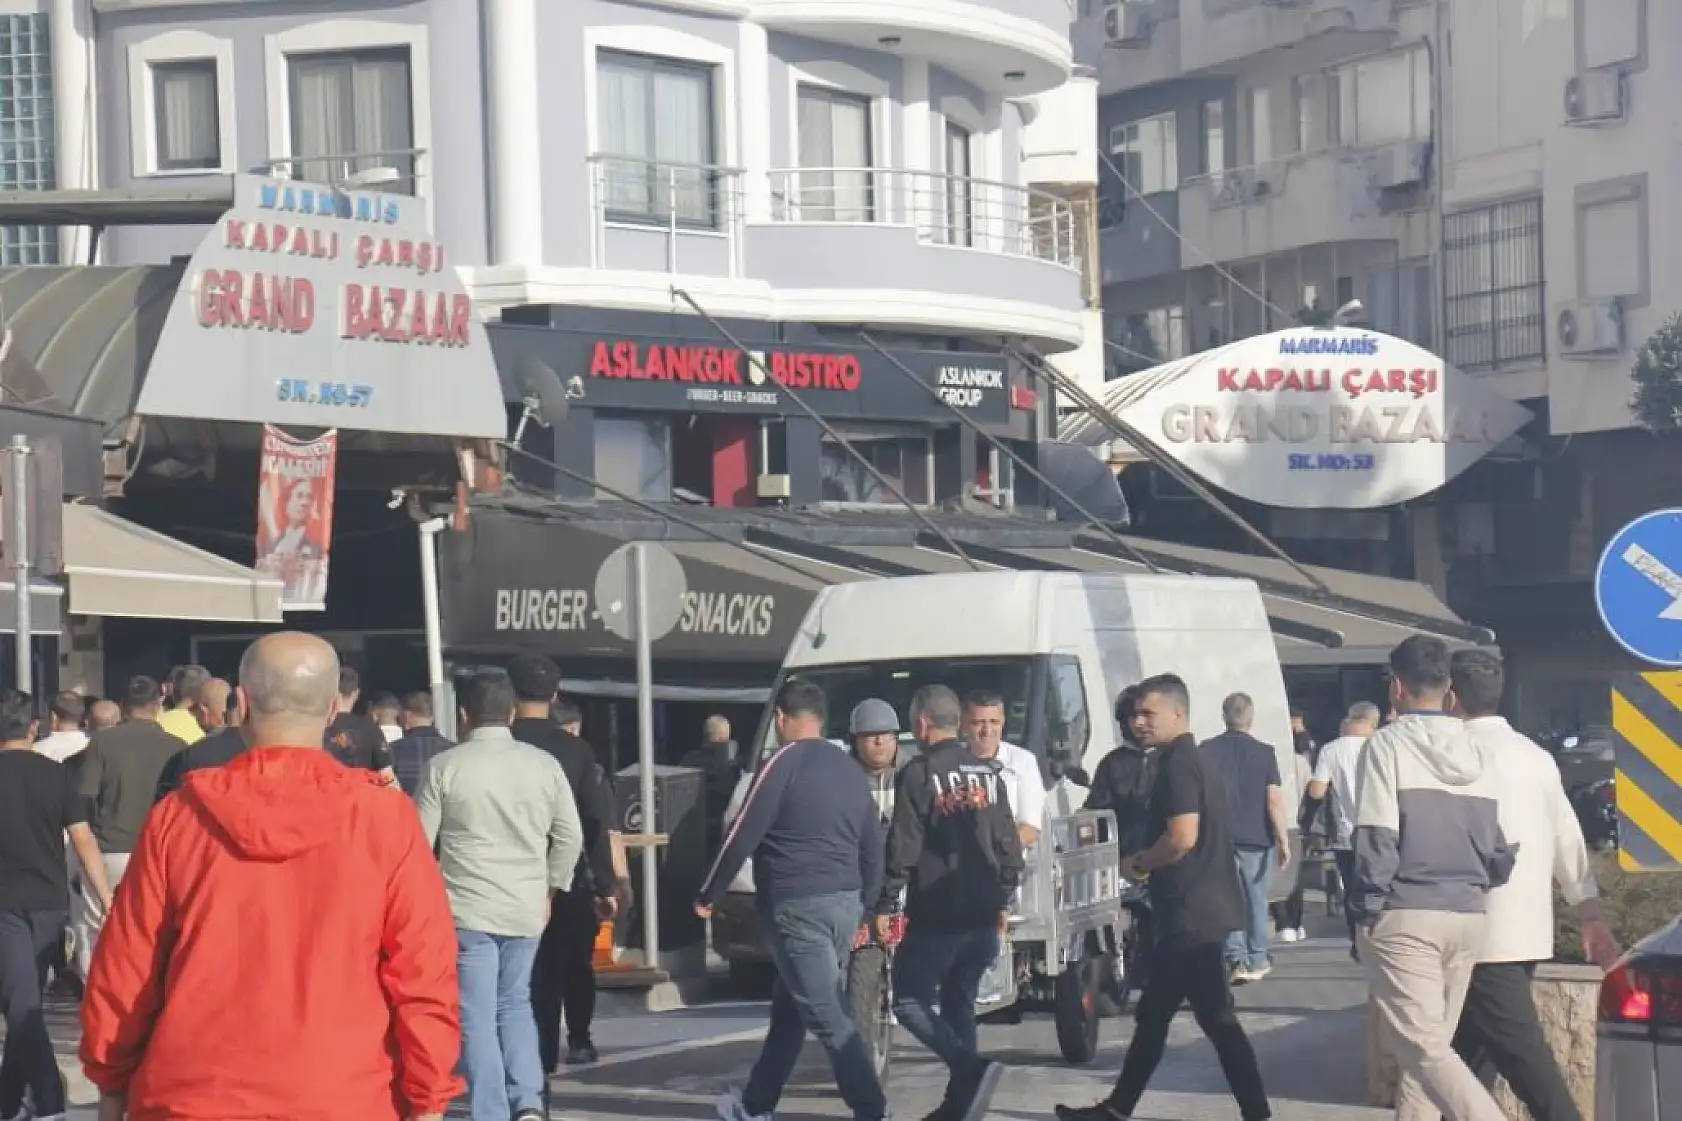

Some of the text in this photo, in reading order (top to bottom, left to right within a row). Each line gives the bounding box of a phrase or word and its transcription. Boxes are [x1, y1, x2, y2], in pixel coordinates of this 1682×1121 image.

[225, 220, 338, 260] KAPALI
[198, 269, 472, 349] GRAND BAZAAR
[770, 350, 862, 391] BISTRO
[1217, 368, 1438, 400] KAPALI ÇARŞI
[938, 388, 982, 408] GROUP
[1160, 403, 1318, 443] GRAND
[496, 588, 774, 636] BURGER SNACKS
